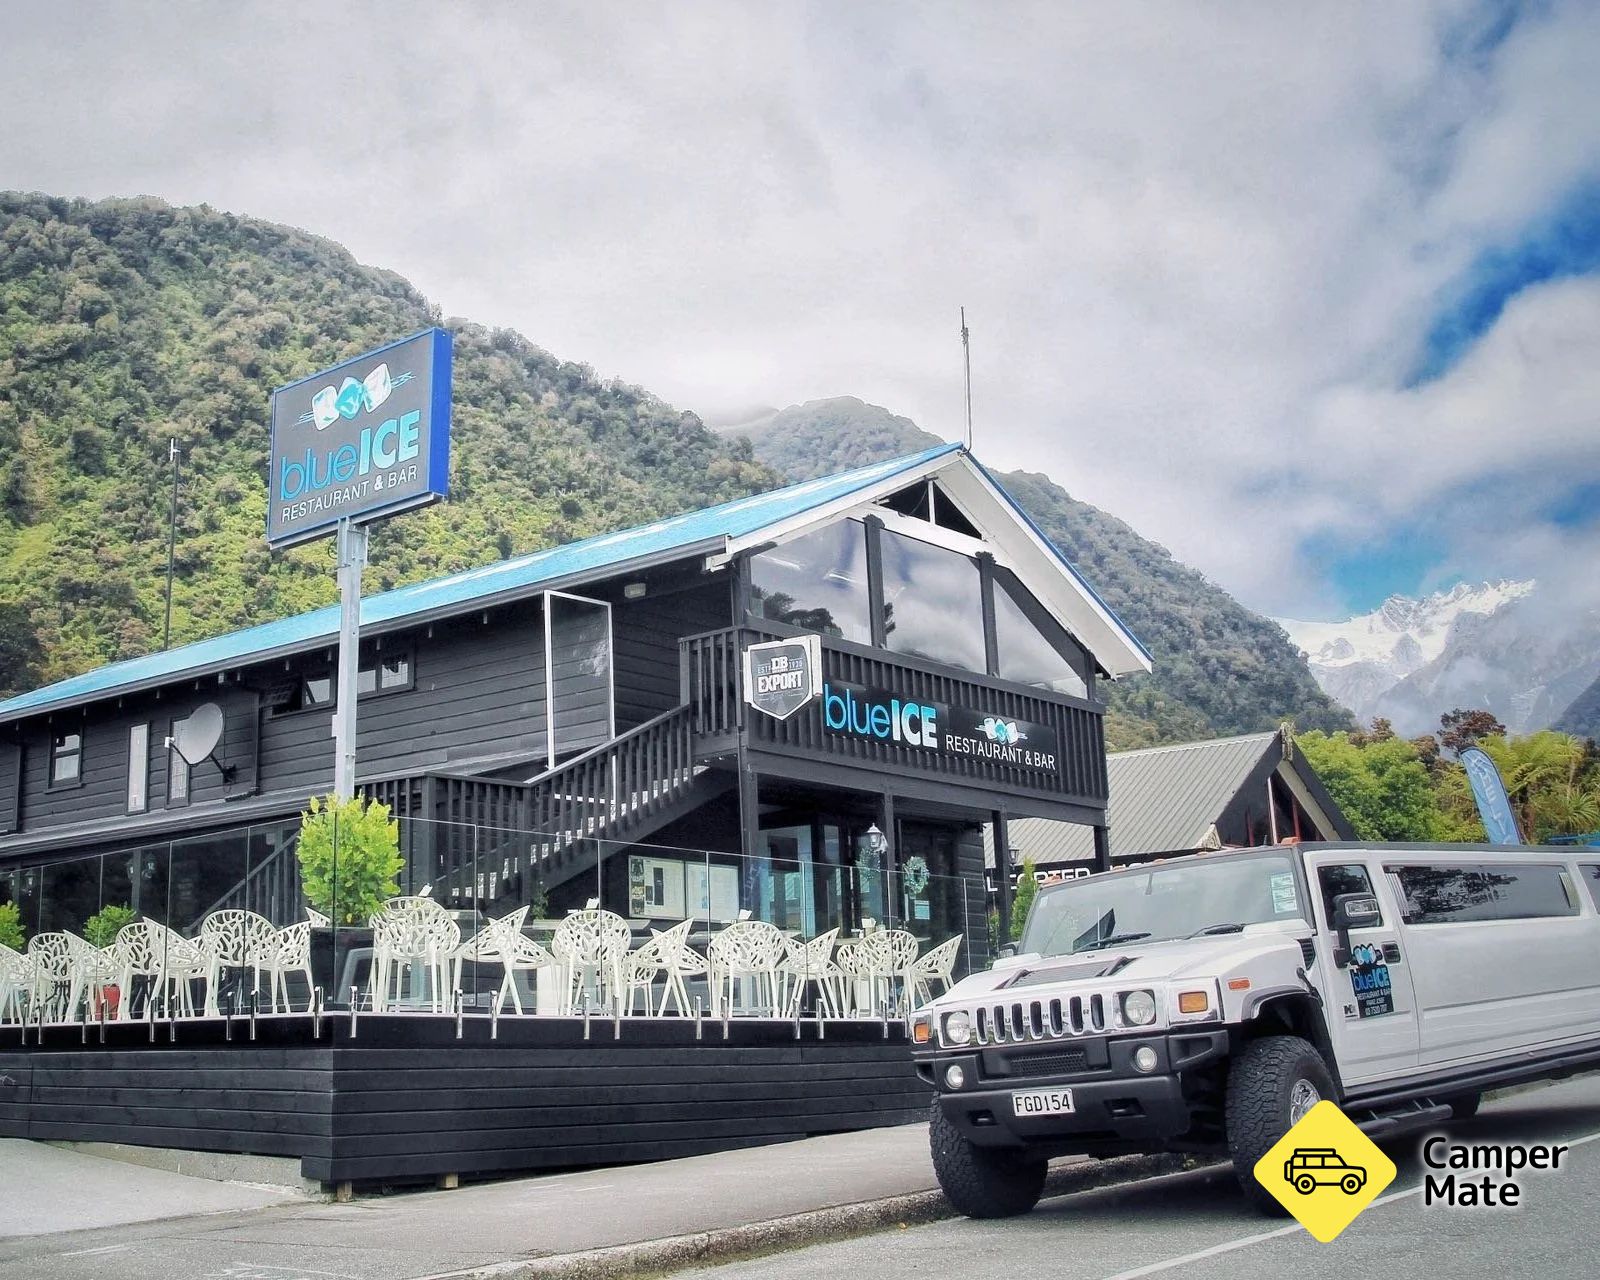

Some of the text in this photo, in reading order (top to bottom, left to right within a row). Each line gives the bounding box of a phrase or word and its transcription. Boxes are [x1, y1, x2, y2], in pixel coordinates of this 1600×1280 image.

[280, 409, 420, 501] blueICE
[281, 465, 418, 523] RESTAURANT & BAR
[771, 656, 788, 670] DB
[757, 670, 804, 693] EXPORT
[823, 683, 938, 749] blueICE
[945, 734, 1057, 770] RESTAURANT & BAR
[987, 1008, 1090, 1026] HUMMER
[1015, 1094, 1070, 1112] FGD154
